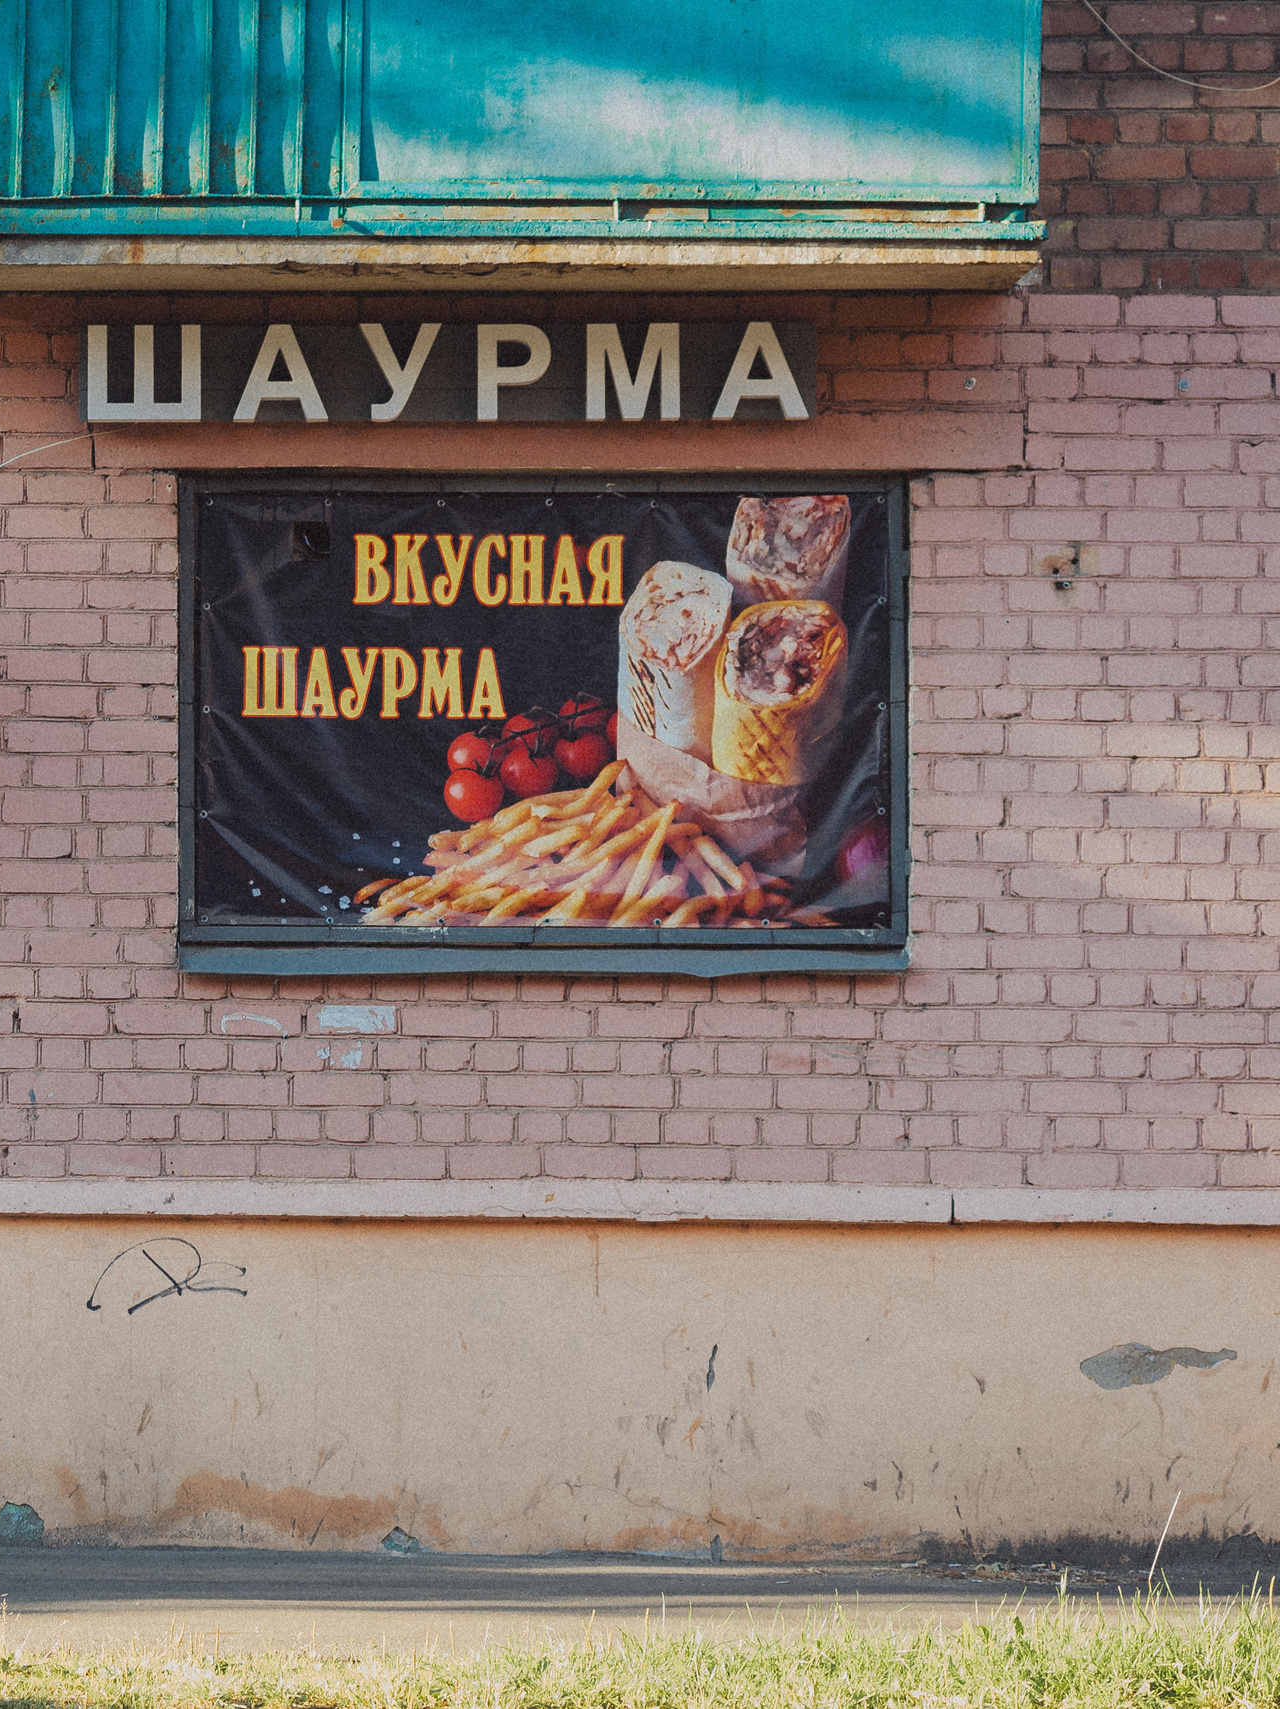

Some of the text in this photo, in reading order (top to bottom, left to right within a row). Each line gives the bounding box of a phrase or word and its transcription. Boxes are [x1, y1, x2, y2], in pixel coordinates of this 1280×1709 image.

[86, 321, 810, 423] ШАУРМА
[353, 533, 626, 606] ВКУСНАЯ
[242, 645, 507, 720] ШАУРМА
